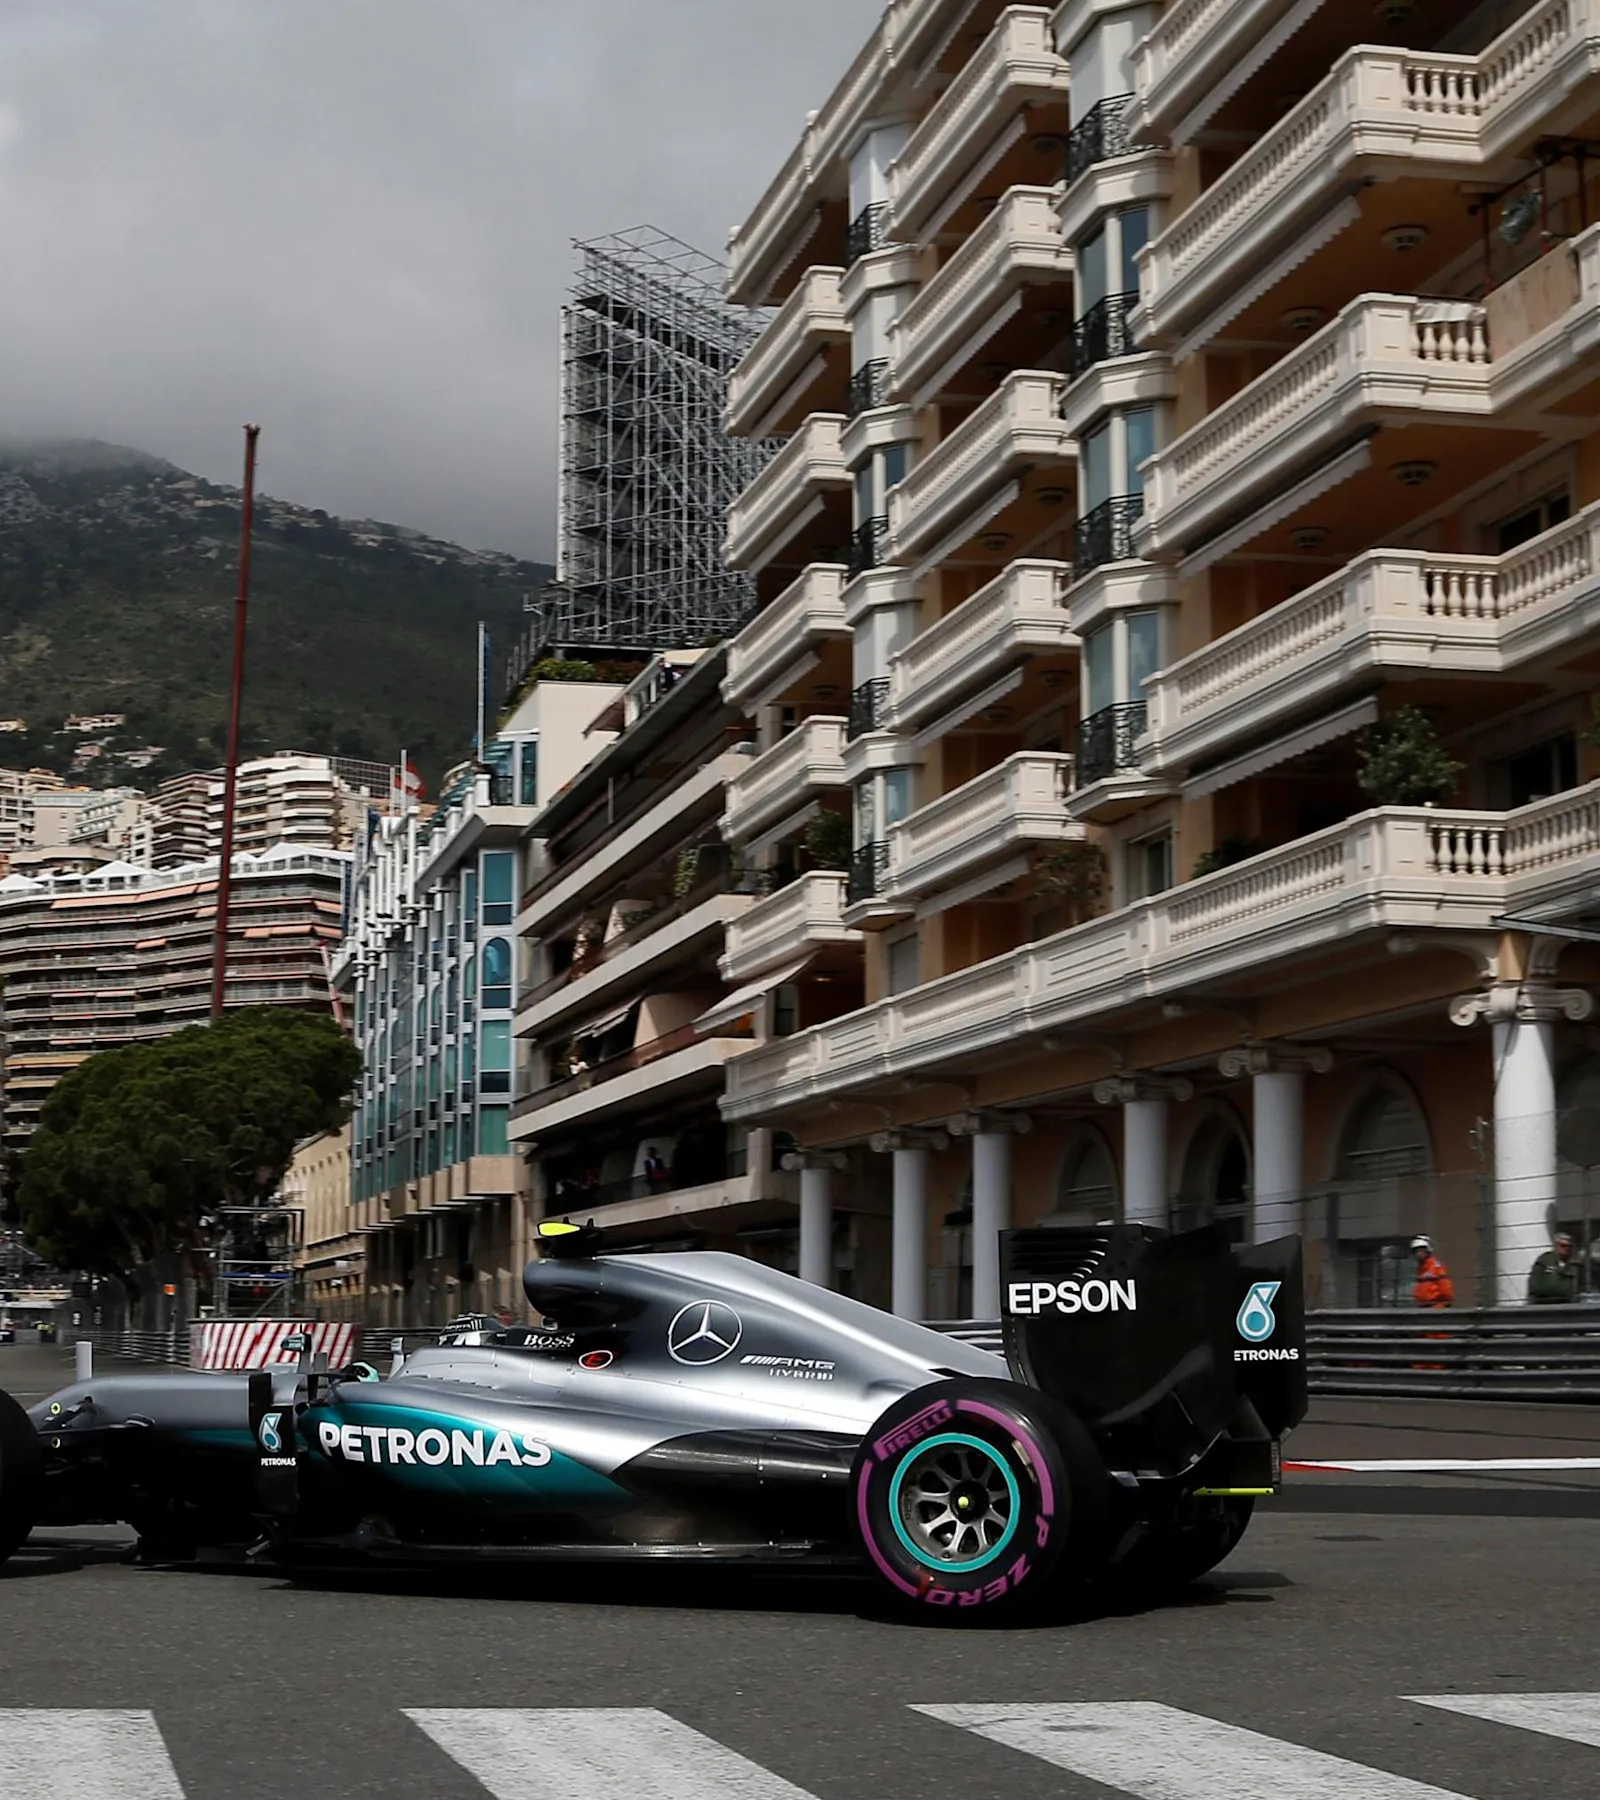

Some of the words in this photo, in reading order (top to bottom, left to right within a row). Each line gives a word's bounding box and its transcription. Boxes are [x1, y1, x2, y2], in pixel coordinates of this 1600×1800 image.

[1008, 1279, 1137, 1314] EPSON
[523, 1332, 576, 1346] BOSS
[771, 1357, 836, 1370] AMG
[1233, 1347, 1300, 1362] ETRONAS
[769, 1368, 834, 1381] HYBRID
[872, 1398, 956, 1463] PIRELLI
[318, 1421, 552, 1467] PETRONAS
[260, 1456, 297, 1467] PETRONAS
[1035, 1514, 1050, 1548] P
[923, 1553, 1032, 1607] ZERO
